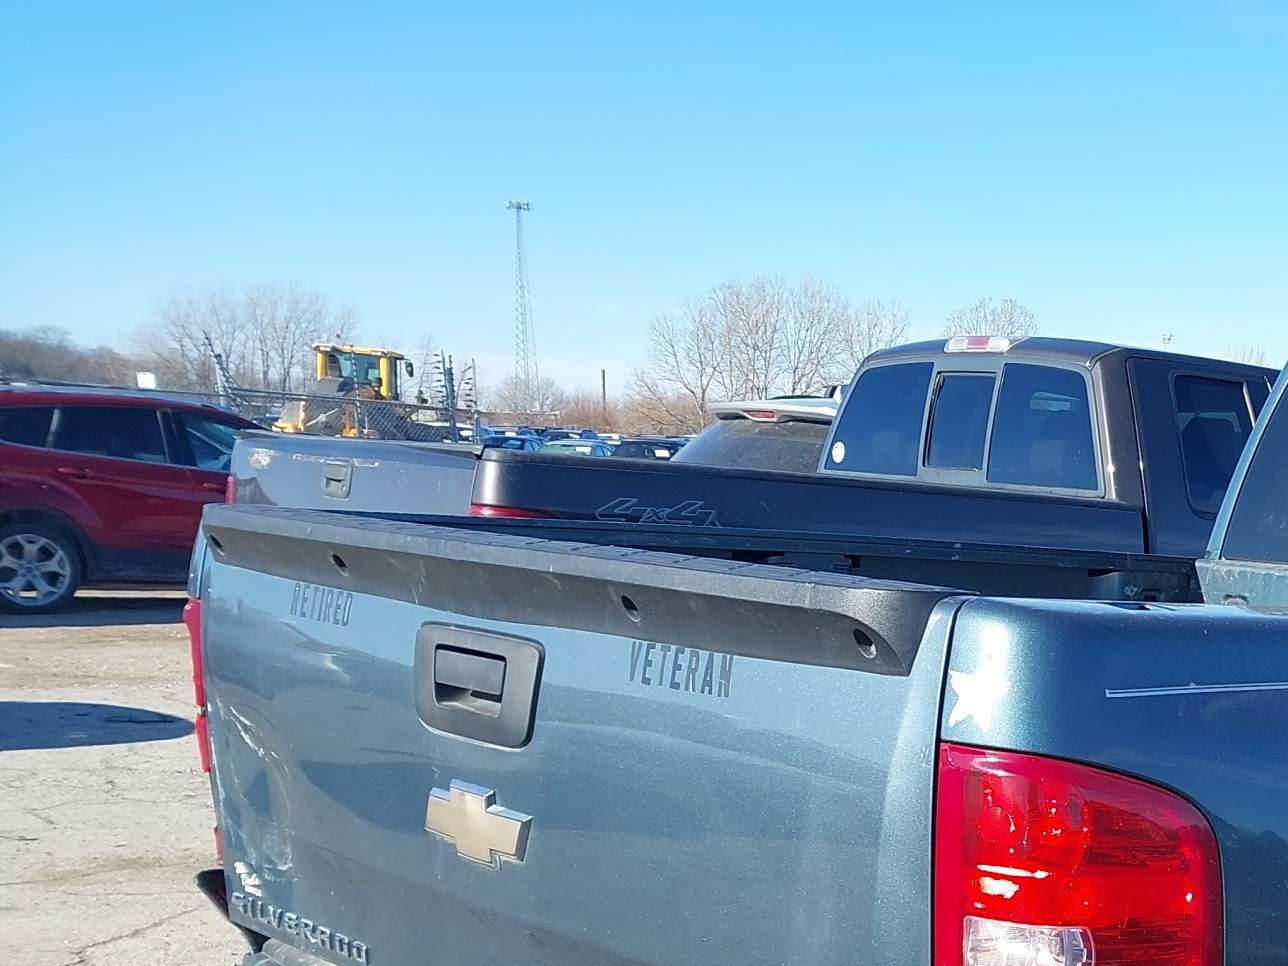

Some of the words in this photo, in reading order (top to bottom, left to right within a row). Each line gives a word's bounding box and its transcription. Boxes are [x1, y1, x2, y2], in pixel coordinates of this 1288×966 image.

[290, 582, 353, 627] RETIRED
[629, 640, 734, 698] VETERAN
[231, 892, 369, 966] SILVERADO
